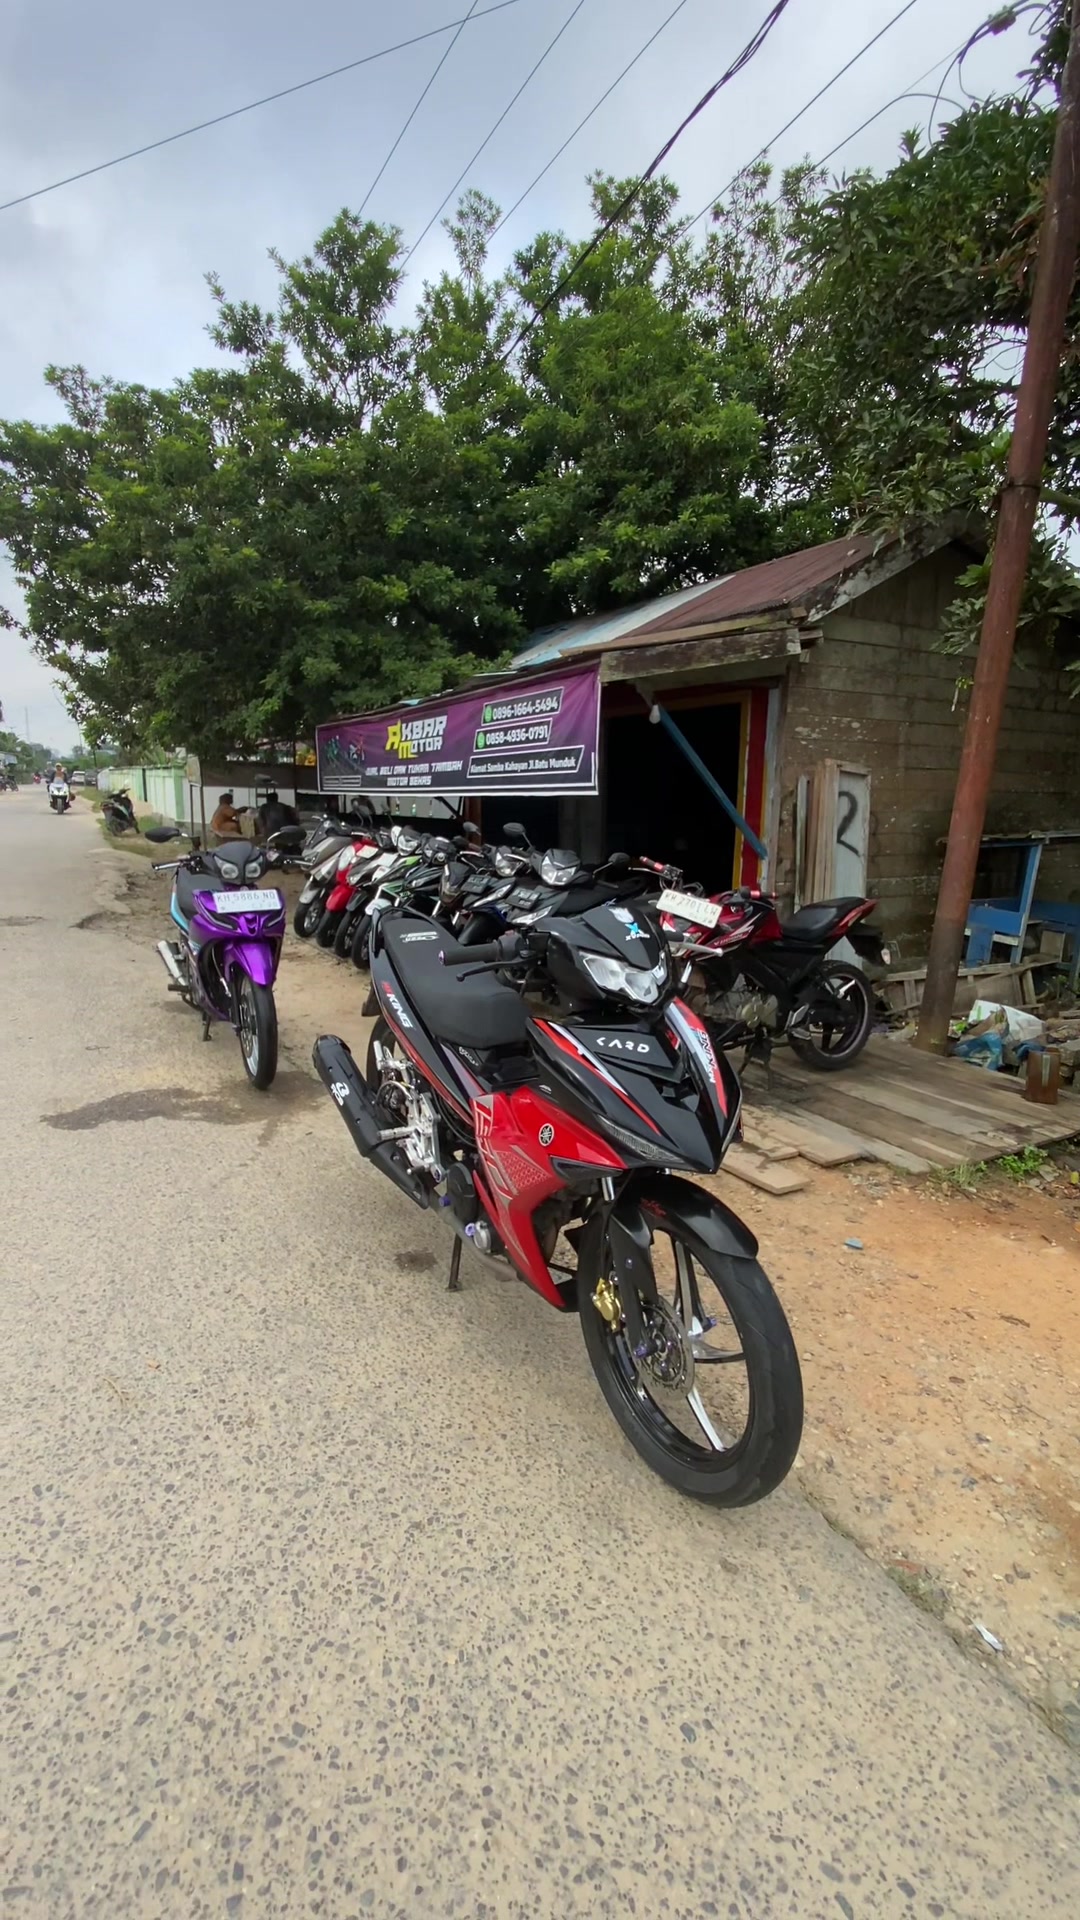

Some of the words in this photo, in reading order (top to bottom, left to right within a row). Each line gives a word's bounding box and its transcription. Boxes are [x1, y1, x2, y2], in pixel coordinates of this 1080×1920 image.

[493, 697, 558, 720] 0896-1664-5494
[385, 715, 448, 751] AKBAR
[486, 725, 548, 745] 0858-4936-0791
[398, 737, 443, 759] MOTOR
[549, 756, 576, 768] Munduk
[836, 791, 860, 858] 2
[387, 993, 414, 1029] KING
[596, 1037, 650, 1053] CARD
